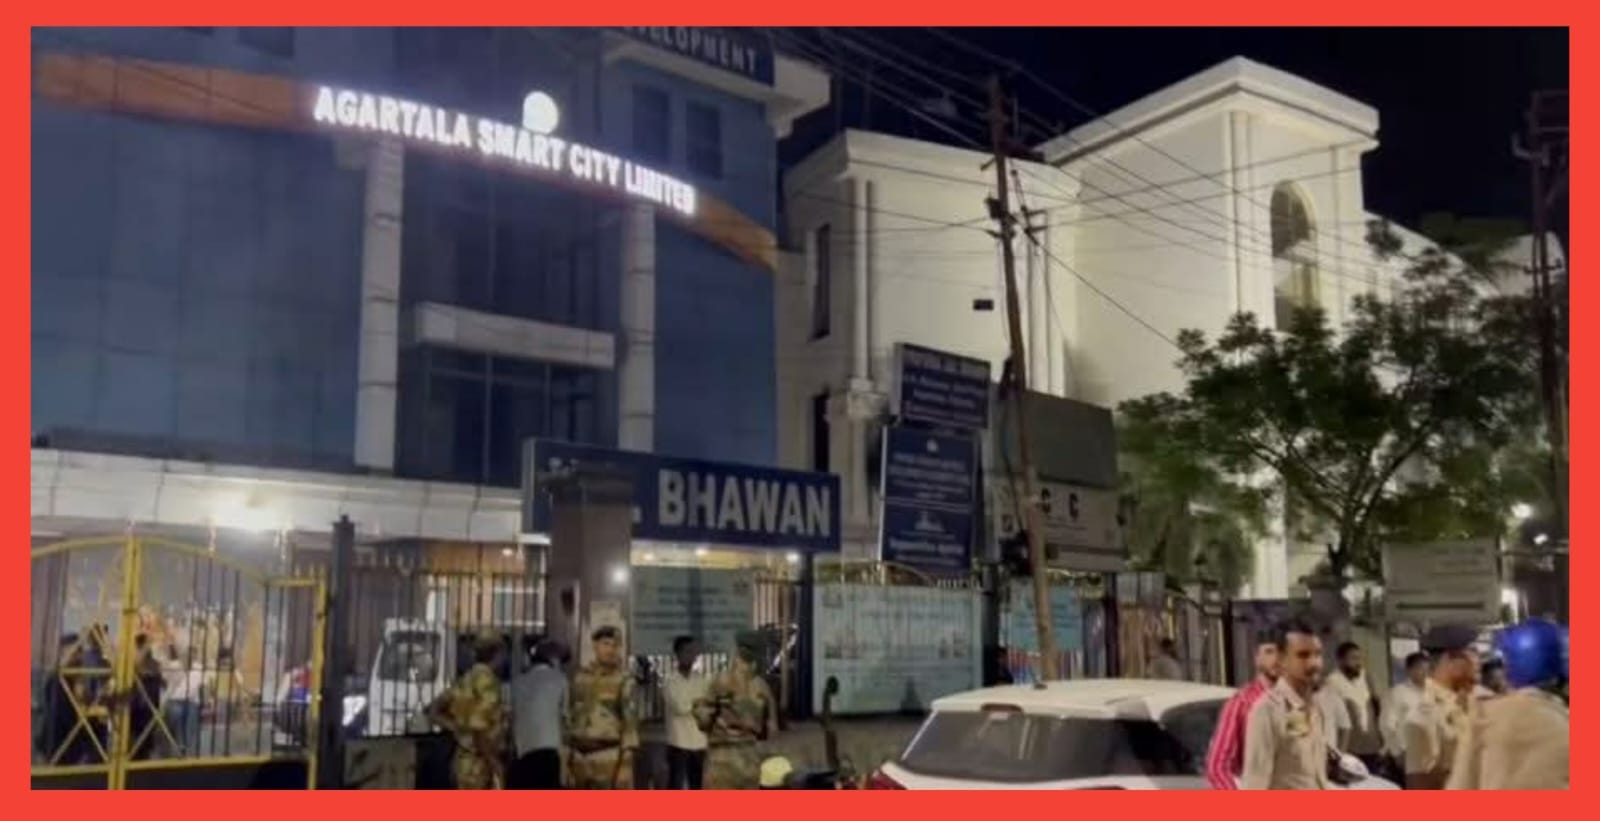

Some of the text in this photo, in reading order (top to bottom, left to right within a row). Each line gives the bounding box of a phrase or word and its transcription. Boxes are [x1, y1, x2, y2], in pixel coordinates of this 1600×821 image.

[623, 27, 756, 73] ELOPMENT
[313, 85, 696, 216] AGARTALA SMART CITY LIMITED
[658, 468, 831, 537] BHAWAN
